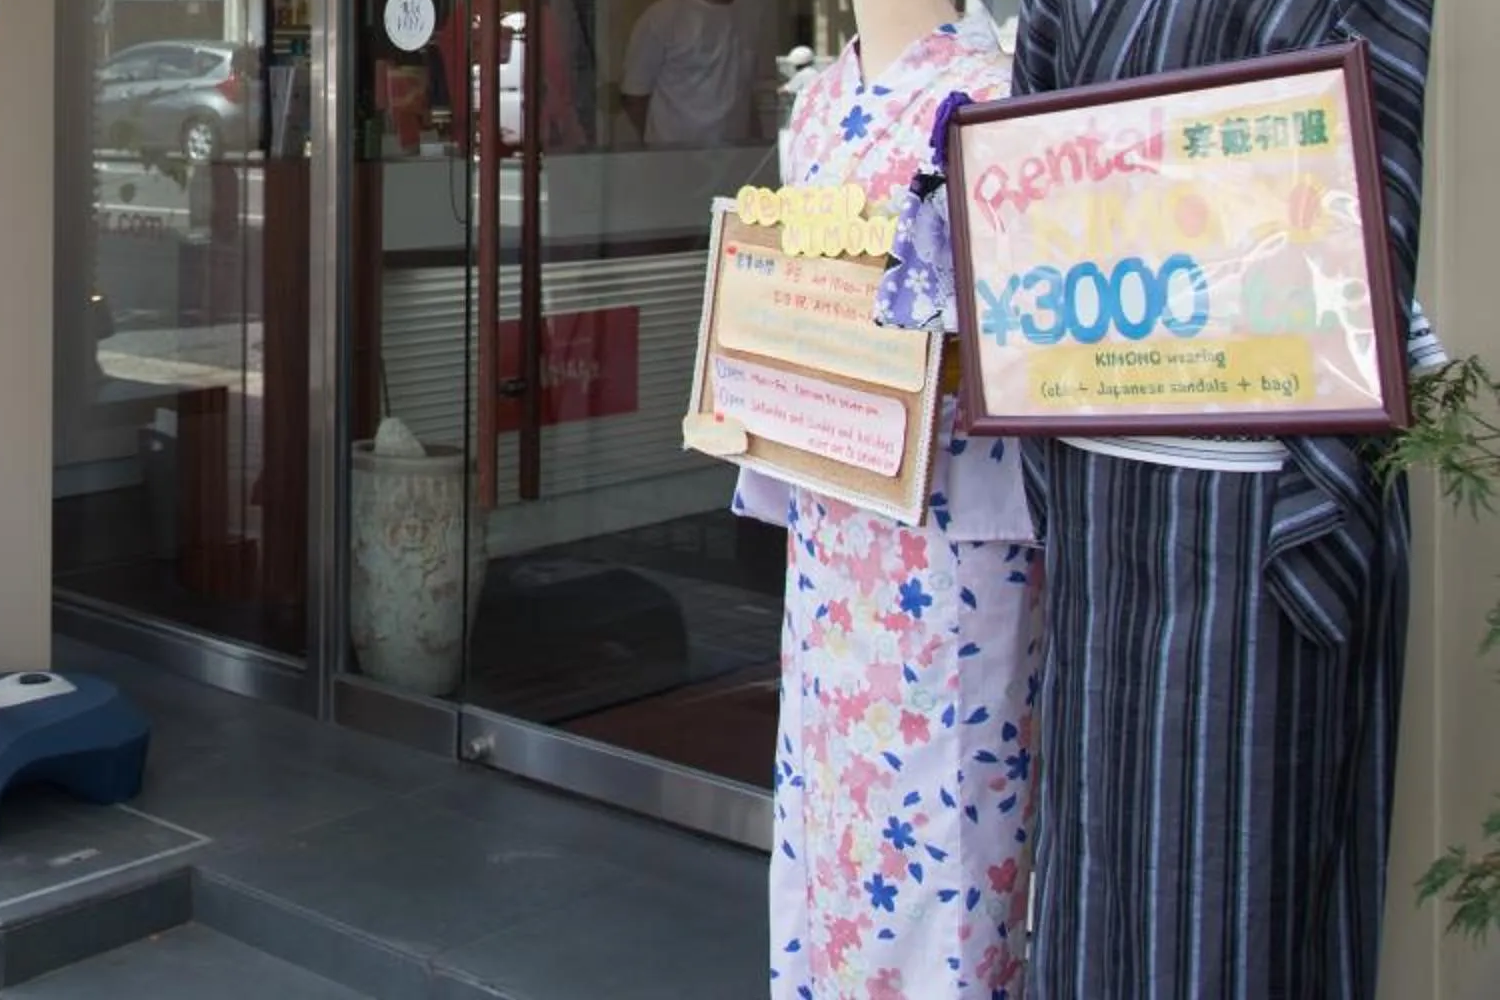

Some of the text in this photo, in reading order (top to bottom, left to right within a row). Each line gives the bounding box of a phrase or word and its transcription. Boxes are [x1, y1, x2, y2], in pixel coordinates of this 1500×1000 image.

[973, 107, 1164, 231] Rental
[789, 220, 886, 246] KIMON
[976, 253, 1210, 346] ¥3000
[1095, 350, 1161, 367] KIMONO
[1097, 380, 1165, 399] Japanese
[1169, 379, 1229, 394] sandals
